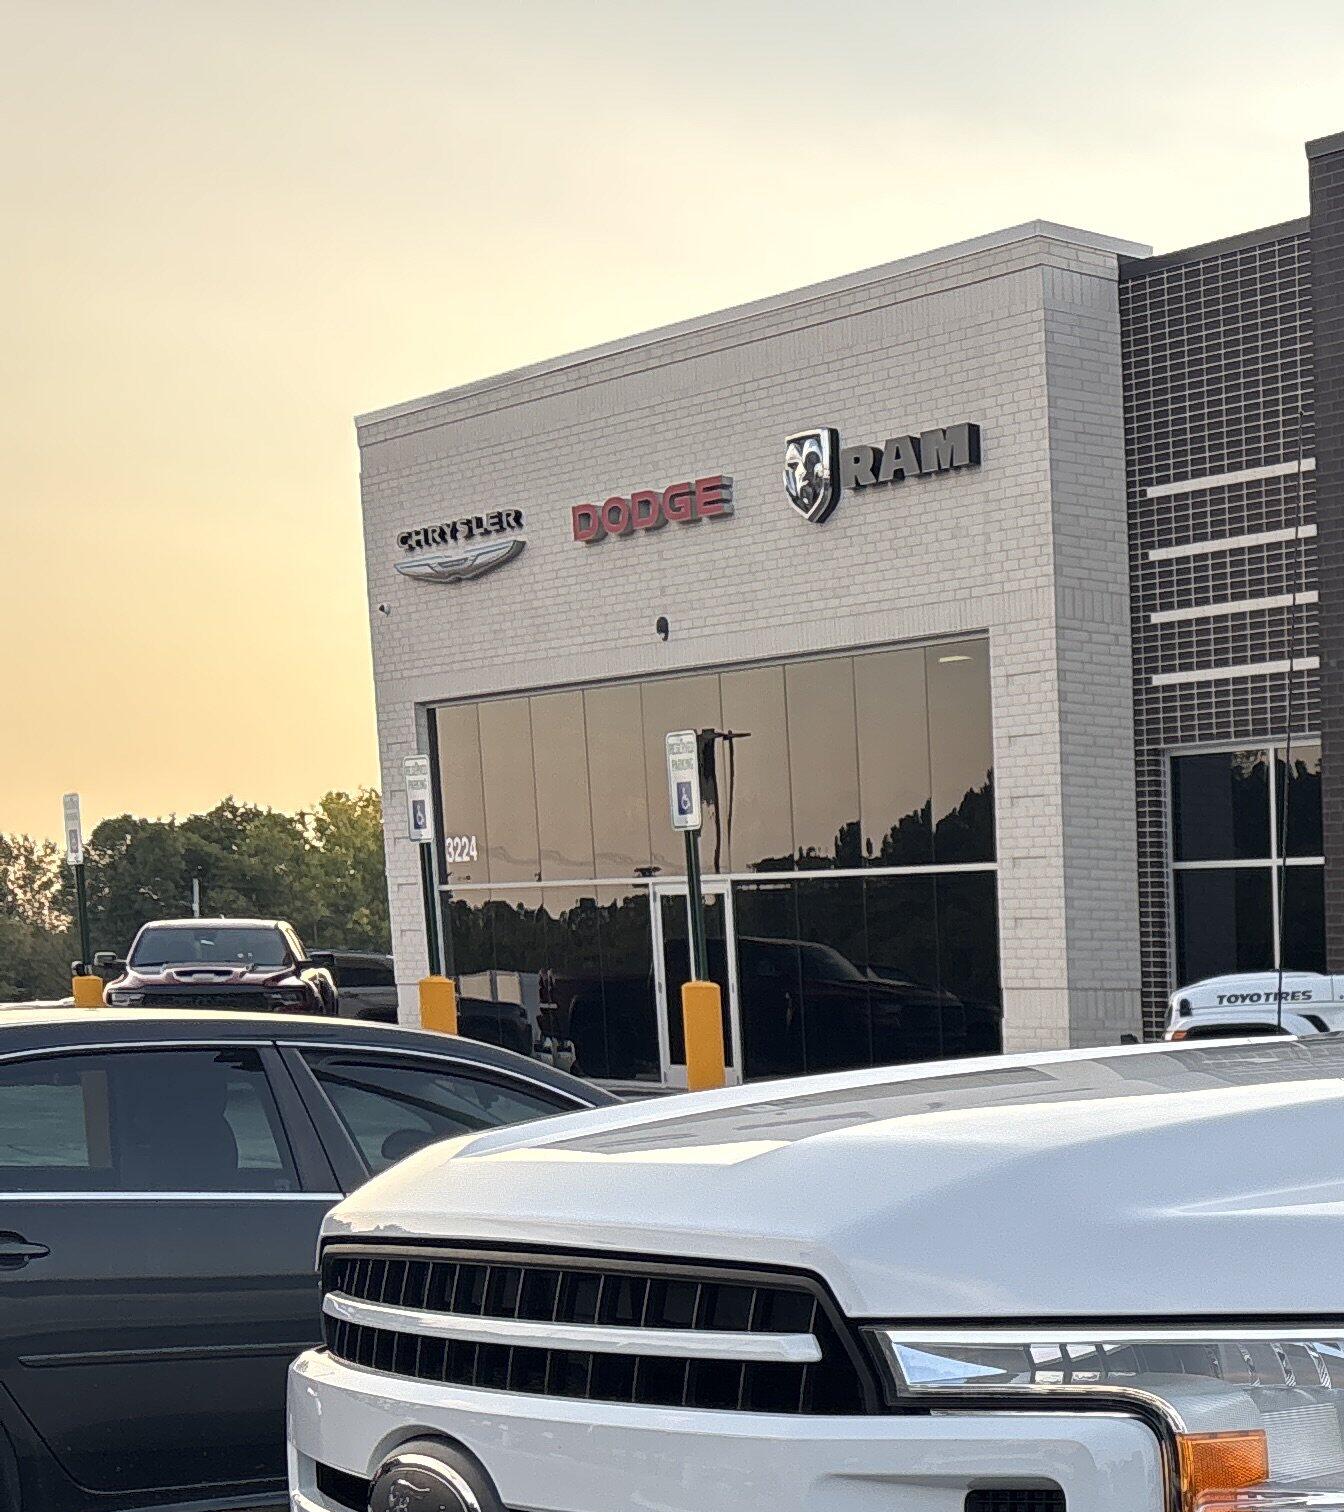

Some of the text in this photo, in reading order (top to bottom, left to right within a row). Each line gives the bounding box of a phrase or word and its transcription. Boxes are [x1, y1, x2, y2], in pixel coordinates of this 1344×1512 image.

[840, 422, 981, 490] RAM
[397, 509, 523, 552] CHRYSLER
[572, 474, 735, 544] DODGE
[445, 835, 478, 863] 3224
[1216, 989, 1313, 1005] TOYO TIRES
